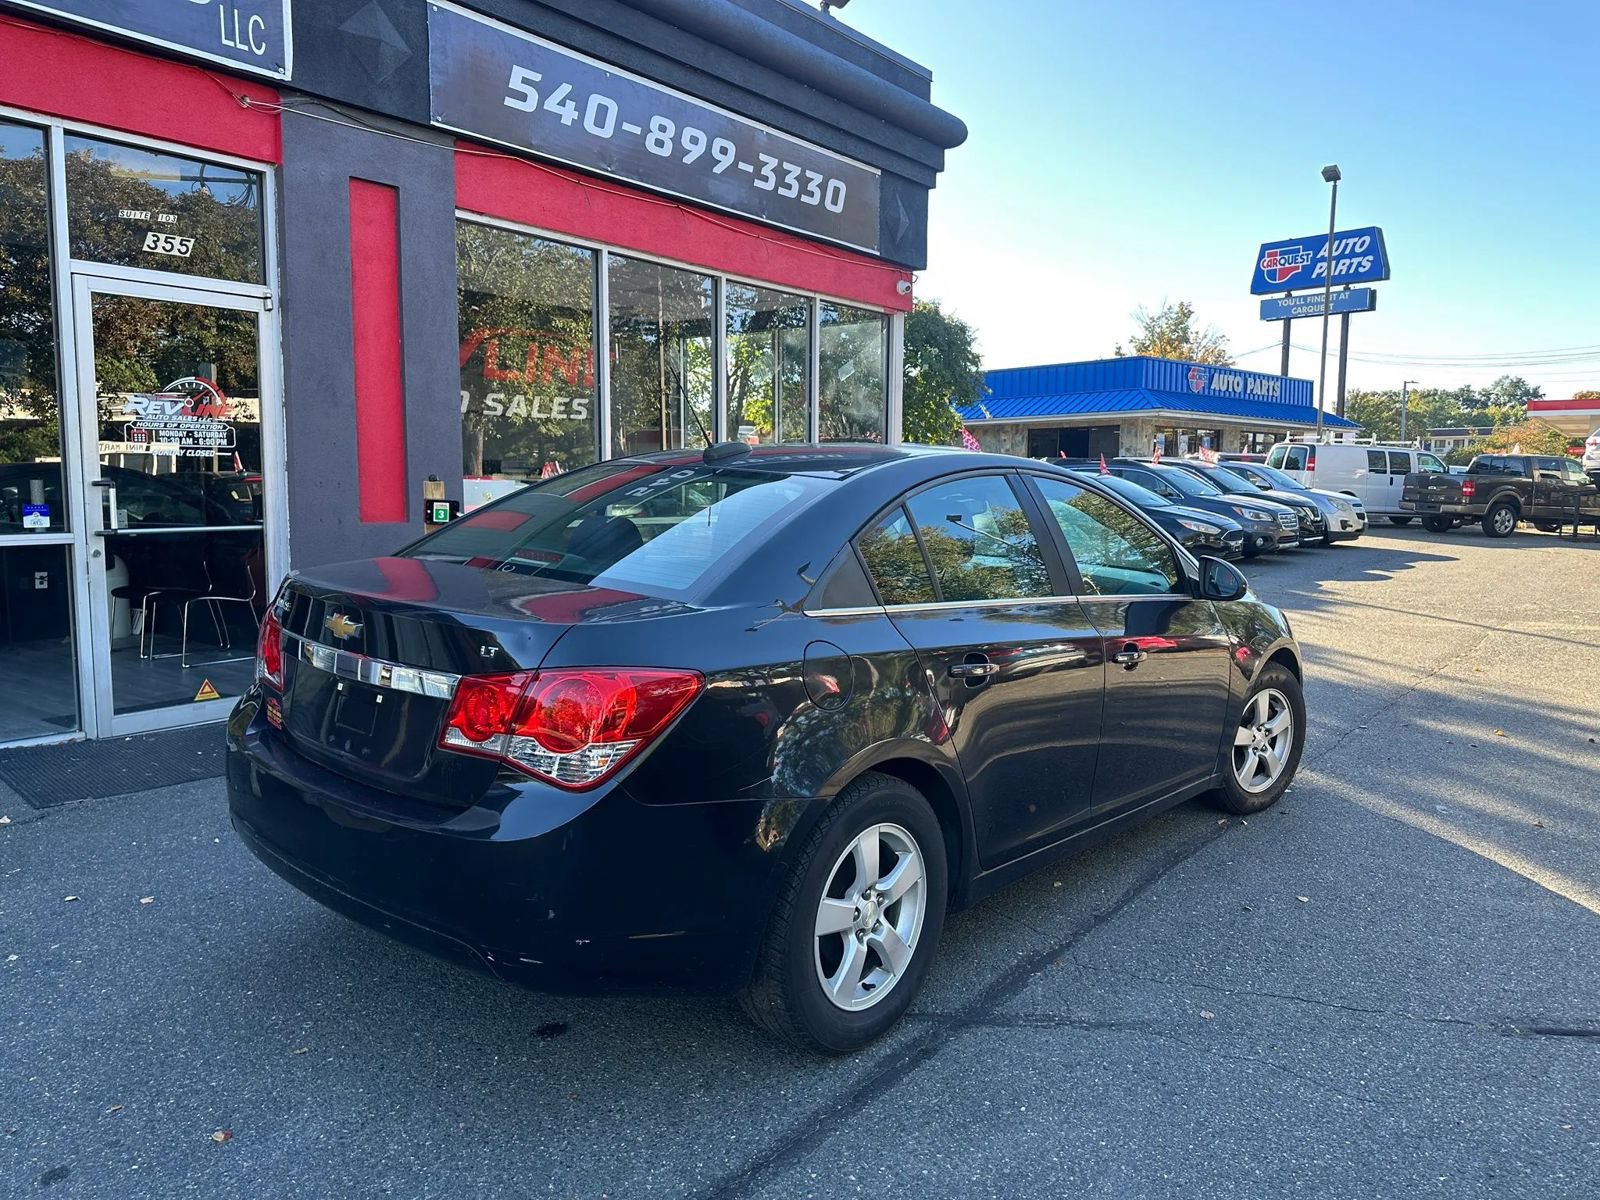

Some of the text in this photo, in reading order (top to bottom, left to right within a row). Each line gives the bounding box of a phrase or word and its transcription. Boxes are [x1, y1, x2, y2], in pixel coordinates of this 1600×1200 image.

[219, 4, 266, 55] LLC
[504, 65, 847, 213] 540-899-3330
[119, 210, 150, 219] SUITE
[146, 233, 191, 255] 355
[1316, 236, 1371, 258] AUTO
[1261, 252, 1311, 270] CARQUEST
[1311, 255, 1374, 279] PARTS
[1278, 296, 1305, 307] YOU'LL
[1339, 292, 1350, 300] AT
[1291, 303, 1334, 315] CARQUET
[1211, 373, 1242, 393] AUTO
[1247, 377, 1280, 397] PARTS
[483, 393, 589, 420] SALES
[136, 421, 165, 429] HOURS
[180, 423, 224, 431] OPERATION
[159, 430, 187, 438] MONDAY
[193, 431, 227, 439] SATURDAY
[181, 438, 193, 446] AM
[199, 438, 215, 446] 6:00
[186, 449, 215, 458] CLOSED
[438, 510, 445, 519] 3
[480, 645, 499, 658] LT
